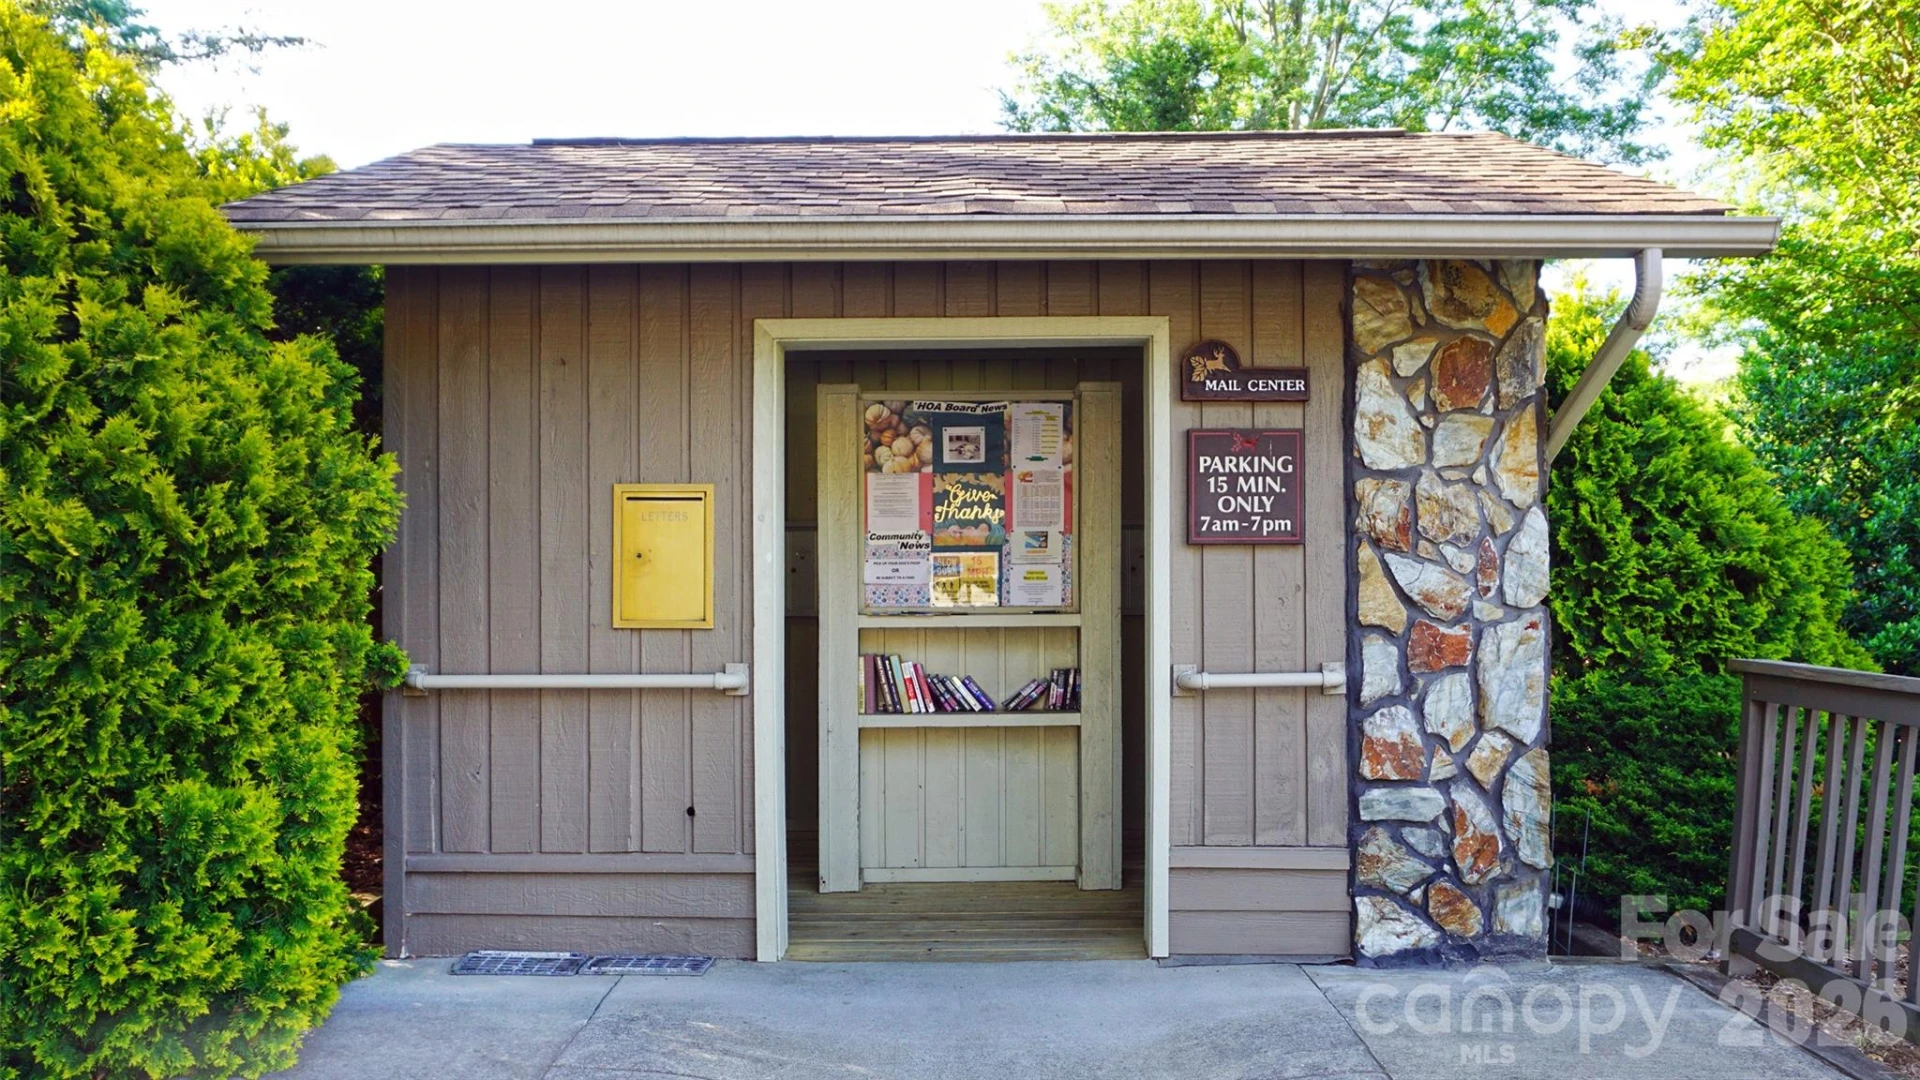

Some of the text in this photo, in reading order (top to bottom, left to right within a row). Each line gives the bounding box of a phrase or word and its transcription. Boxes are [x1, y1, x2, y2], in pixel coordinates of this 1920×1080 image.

[1205, 379, 1305, 392] MAIL CENTER
[981, 404, 1008, 413] News
[1199, 455, 1293, 473] PARKING
[1207, 476, 1287, 493] 15 MIN.
[946, 484, 998, 507] Give
[1217, 495, 1275, 513] ONLY
[641, 511, 689, 522] LETTERS
[869, 533, 924, 541] Community
[900, 541, 930, 550] News
